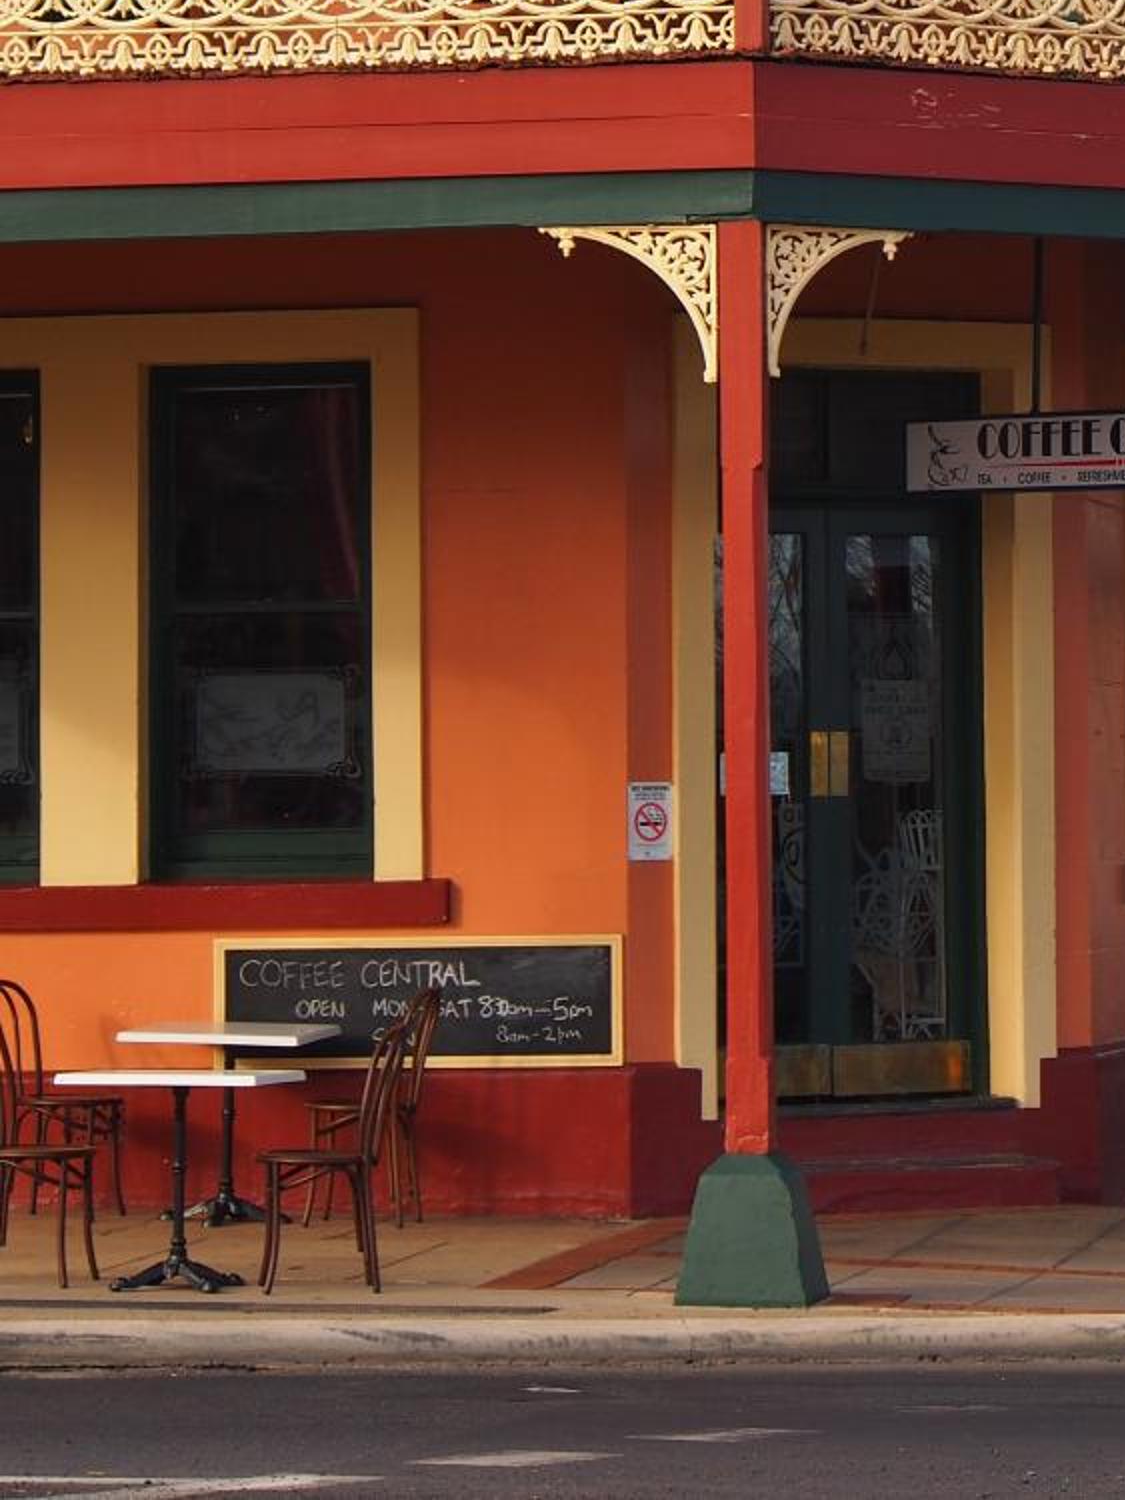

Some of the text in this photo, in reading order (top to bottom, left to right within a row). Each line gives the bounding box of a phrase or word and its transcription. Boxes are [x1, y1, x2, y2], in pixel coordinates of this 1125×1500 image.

[976, 419, 1103, 460] COFFEE
[977, 473, 994, 485] TEA
[1016, 471, 1053, 485] COFFEE
[239, 959, 481, 989] COFFEE CENTRAL
[295, 1000, 347, 1018] OPEN
